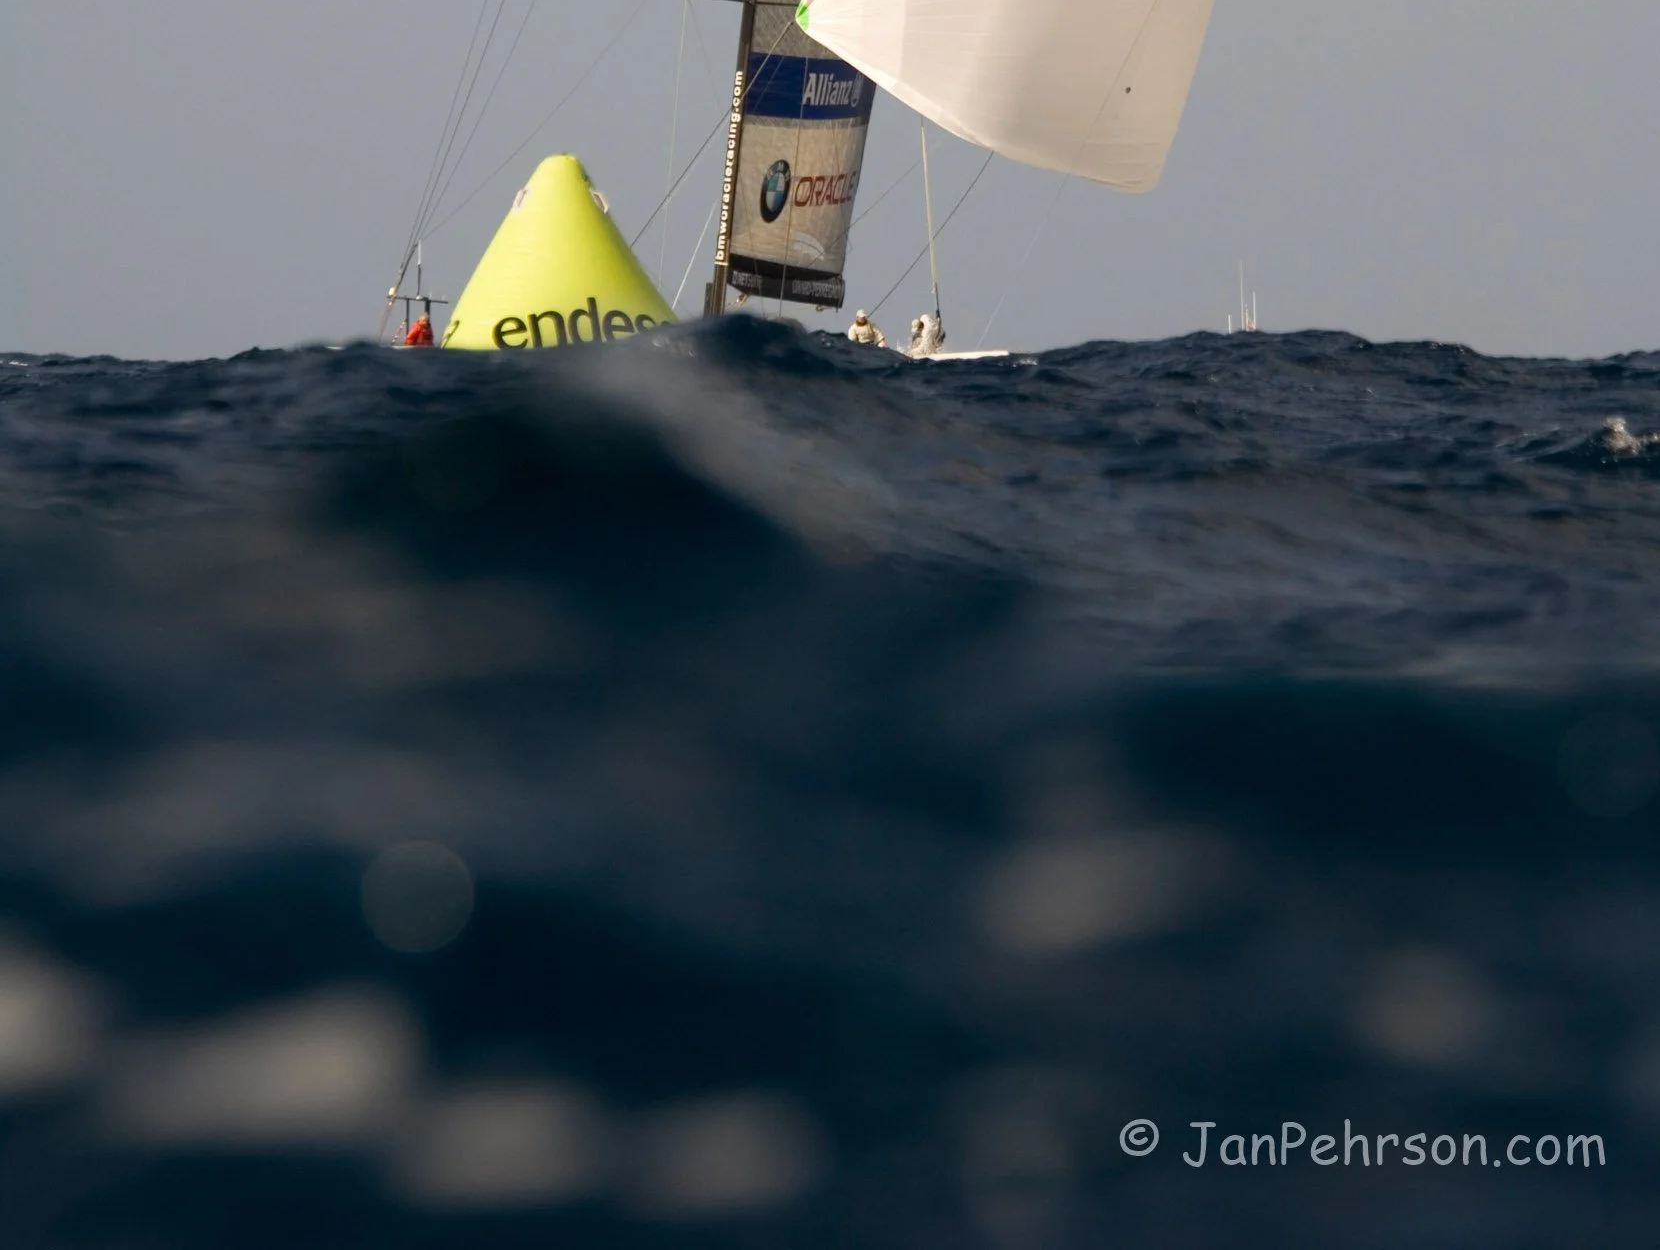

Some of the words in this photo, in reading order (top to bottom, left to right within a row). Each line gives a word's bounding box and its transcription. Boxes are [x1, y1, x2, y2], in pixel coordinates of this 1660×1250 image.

[802, 72, 854, 106] Allianz
[715, 71, 744, 261] bmworacleracing.com
[795, 171, 857, 207] ORACLE
